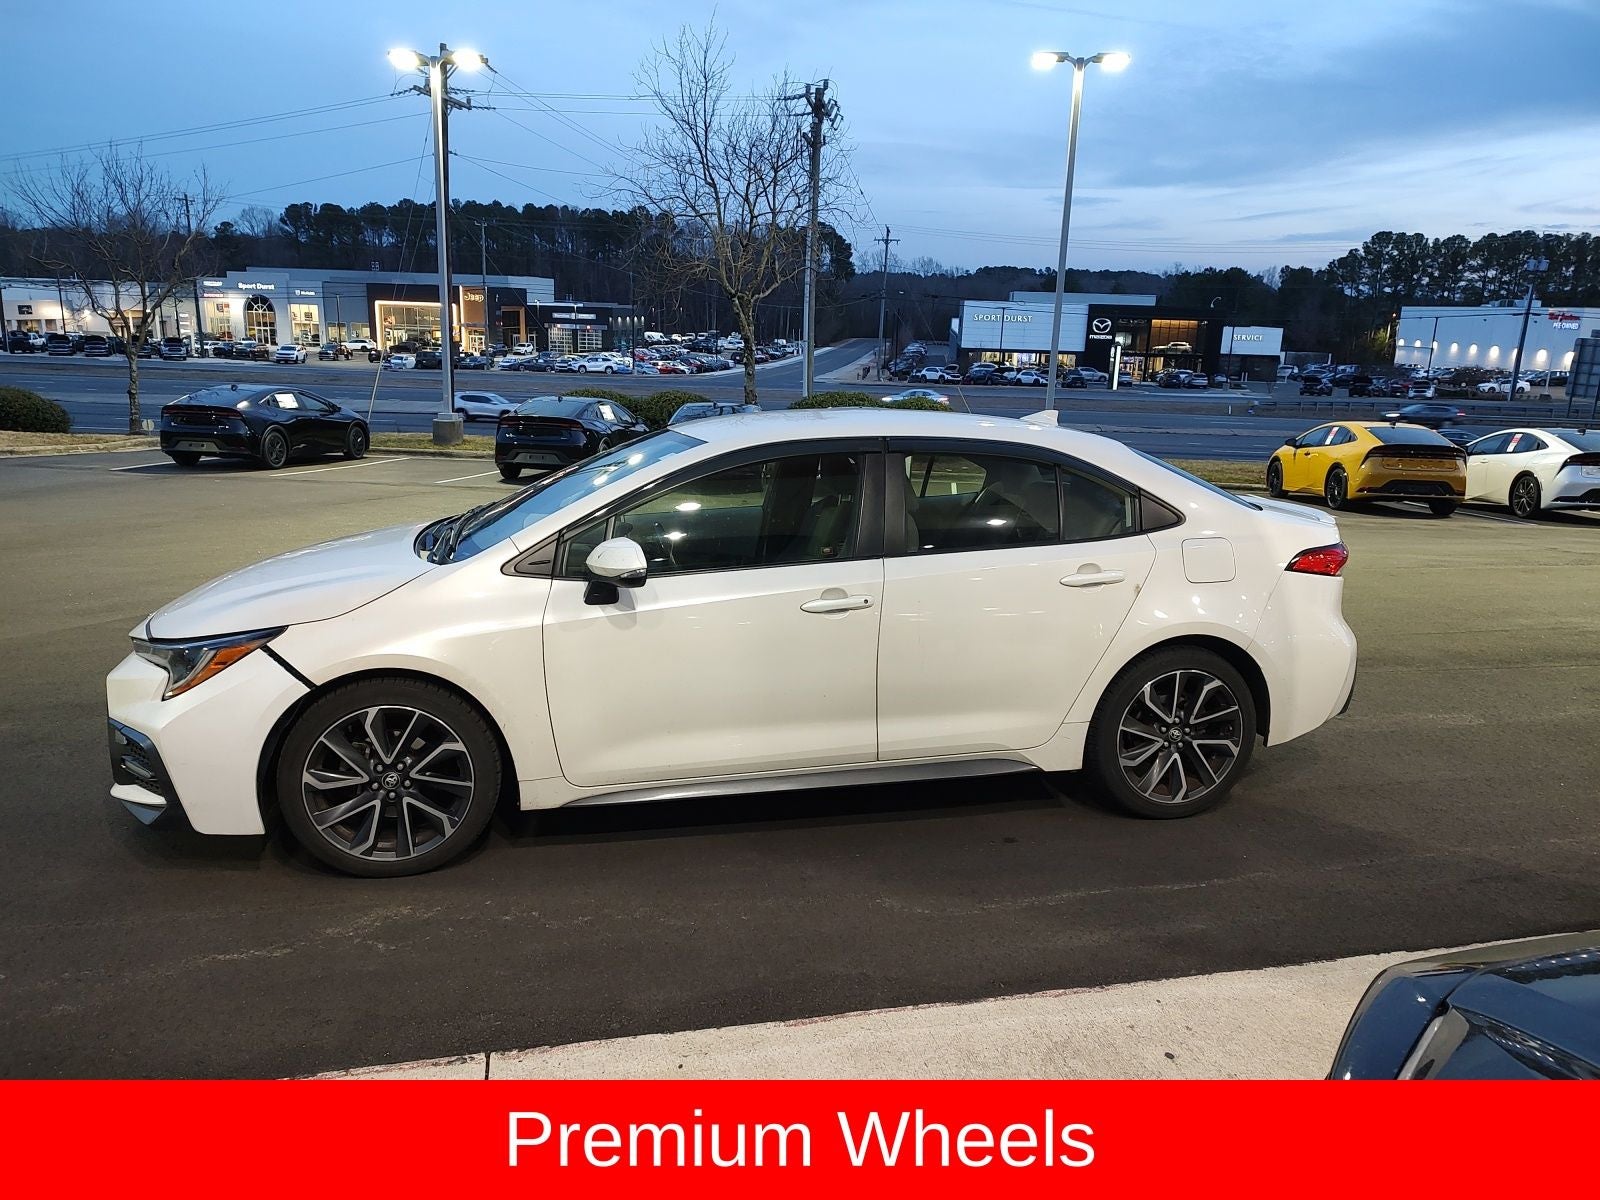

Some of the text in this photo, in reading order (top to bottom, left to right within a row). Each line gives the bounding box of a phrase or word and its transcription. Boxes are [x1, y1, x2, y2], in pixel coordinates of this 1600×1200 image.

[238, 282, 256, 290] Sport
[464, 292, 484, 303] Jeep
[973, 313, 1033, 323] SPORT DURST
